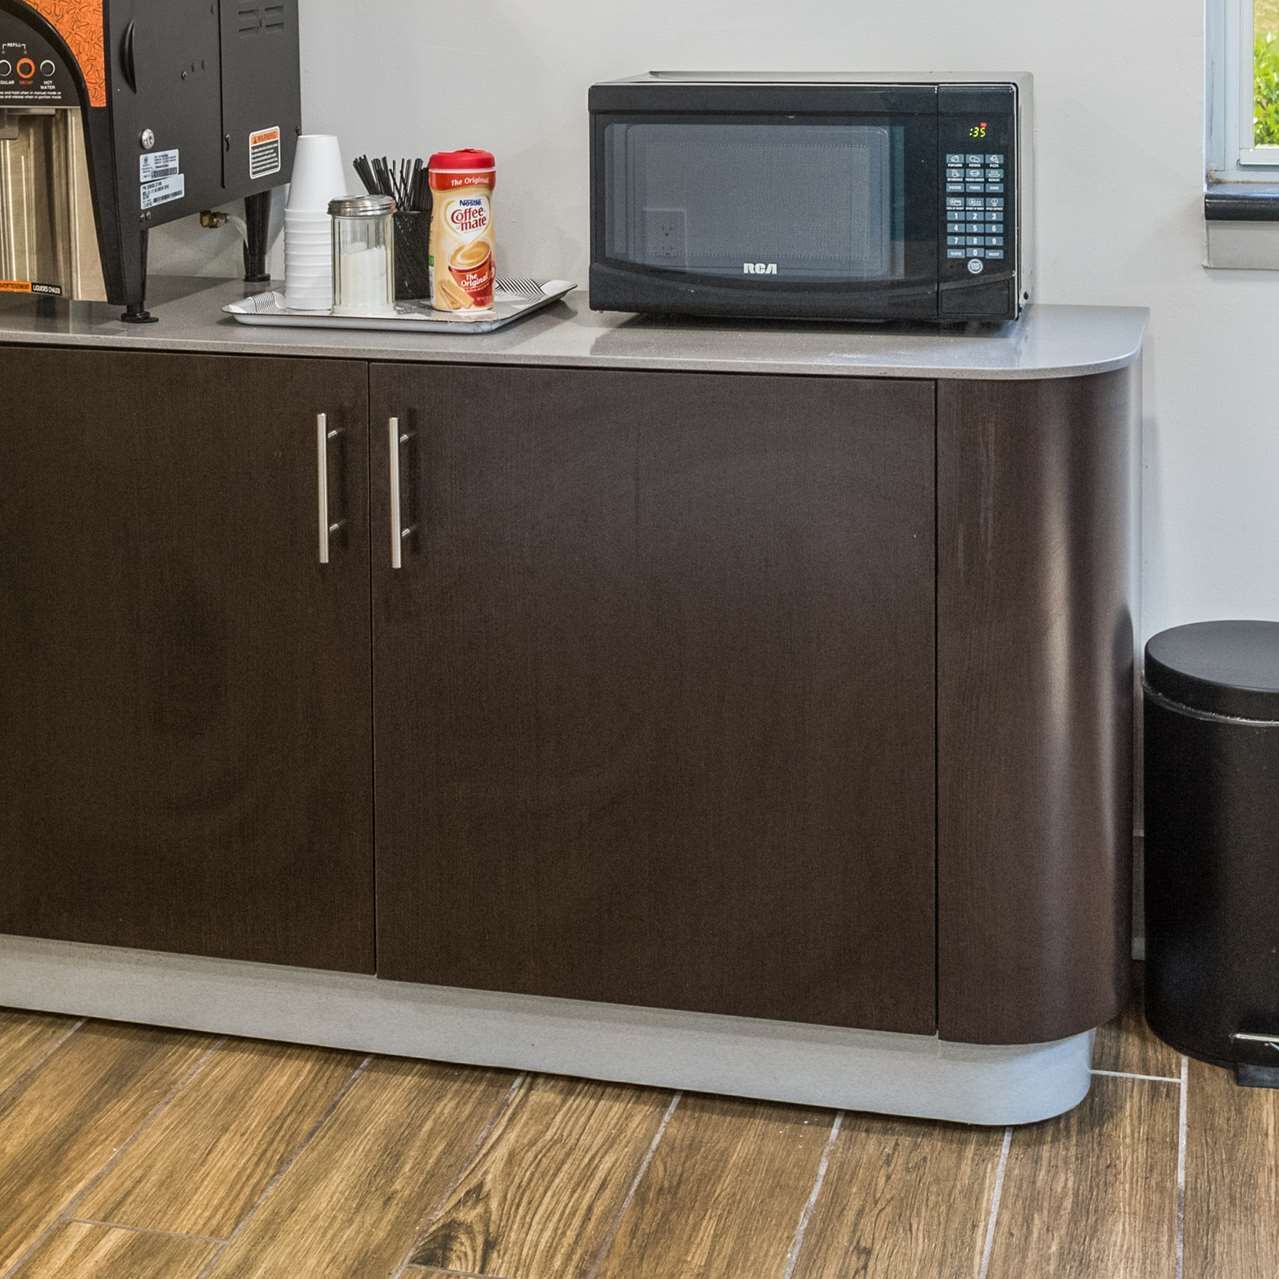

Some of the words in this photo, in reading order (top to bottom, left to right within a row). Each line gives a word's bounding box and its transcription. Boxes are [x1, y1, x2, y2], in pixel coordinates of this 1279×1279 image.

[450, 179, 463, 187] The
[451, 207, 484, 225] Coffee
[954, 212, 959, 220] 1
[972, 212, 978, 220] 2
[461, 216, 487, 231] mate
[954, 237, 959, 245] 7
[743, 262, 778, 275] RCA
